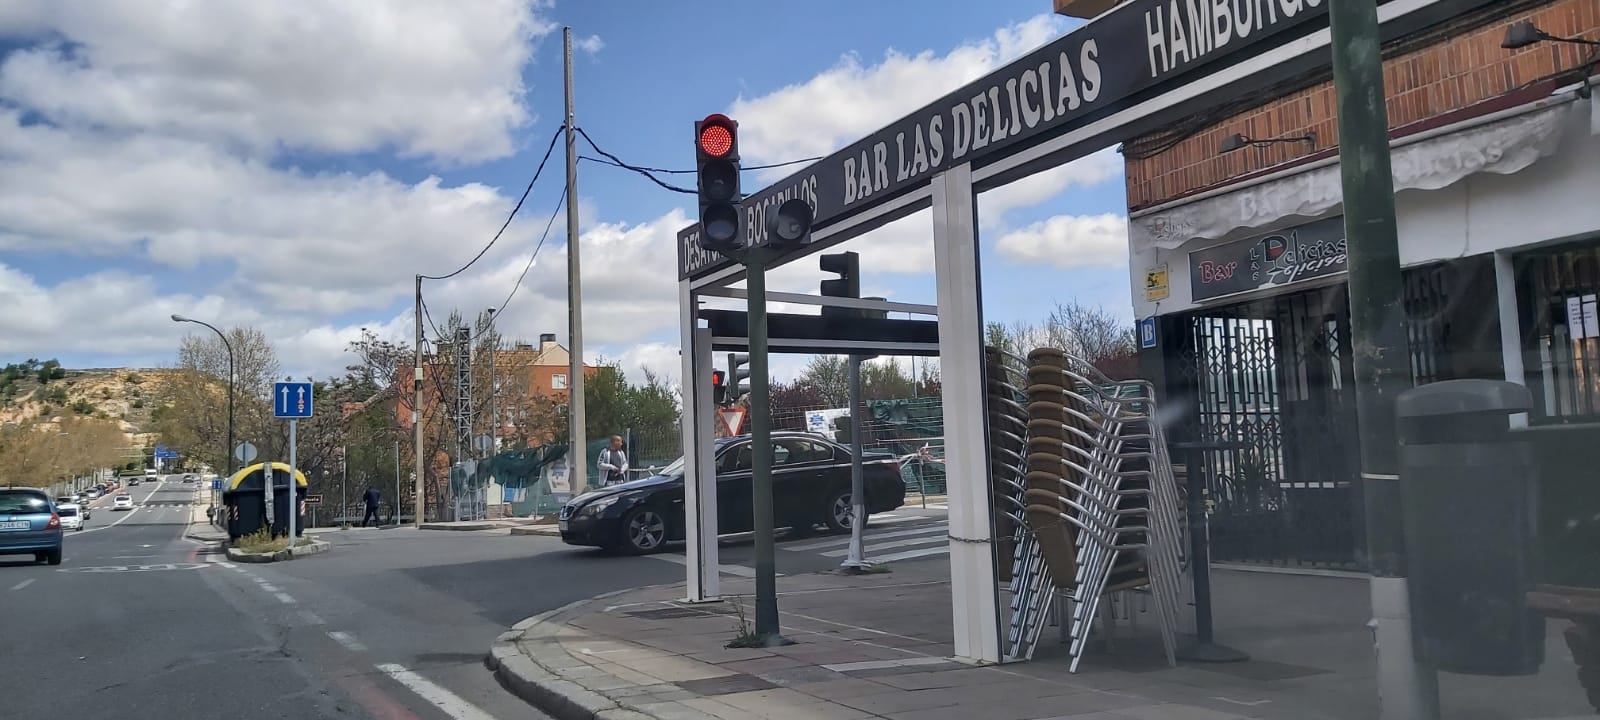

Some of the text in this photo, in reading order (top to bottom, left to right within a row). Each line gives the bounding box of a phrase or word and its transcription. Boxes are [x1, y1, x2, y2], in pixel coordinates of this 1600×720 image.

[844, 141, 888, 205] BAR
[896, 115, 943, 182] LAS
[952, 38, 1102, 158] DELICIAS
[1199, 260, 1238, 283] Bar
[1143, 323, 1154, 343] B
